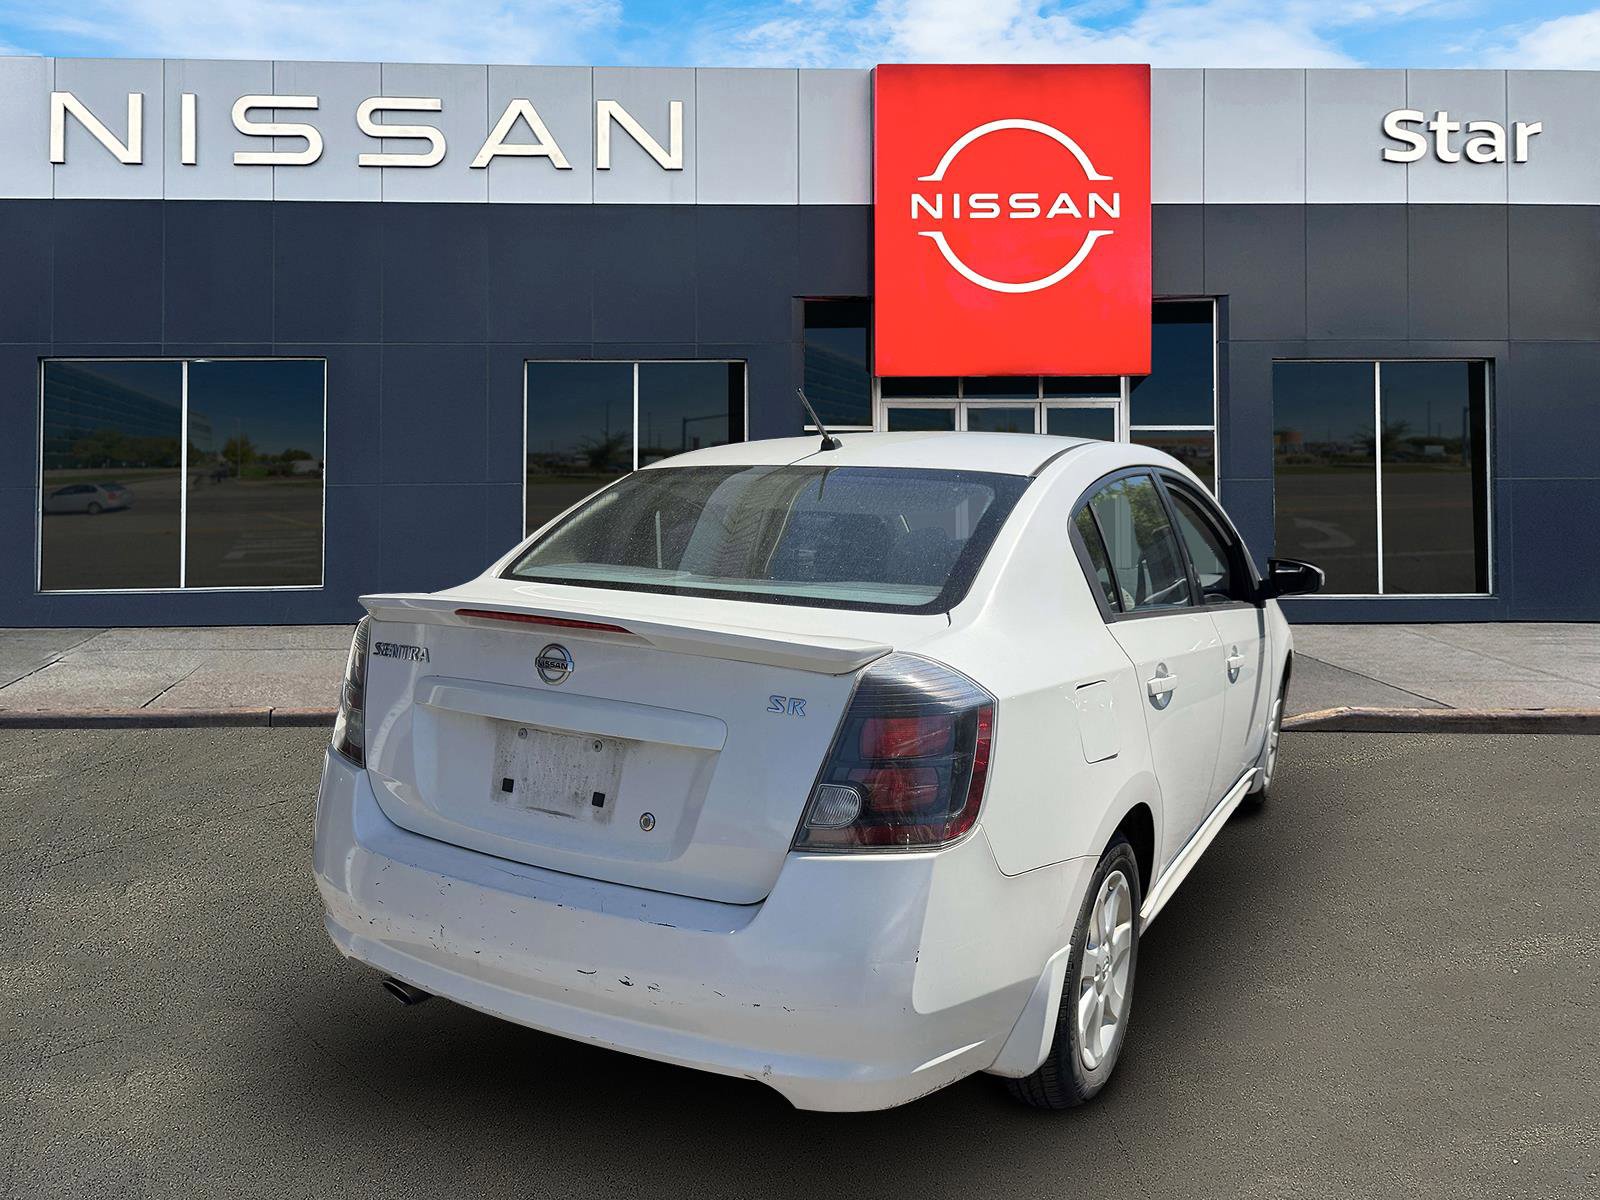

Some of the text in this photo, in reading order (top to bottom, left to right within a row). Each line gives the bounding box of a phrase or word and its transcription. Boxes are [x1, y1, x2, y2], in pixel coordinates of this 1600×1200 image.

[49, 91, 684, 170] NISSAN
[1381, 108, 1543, 164] Star
[910, 192, 1121, 219] NISSAN
[373, 641, 430, 663] SENTRA
[537, 659, 569, 670] NISSAN
[766, 694, 807, 717] SR
